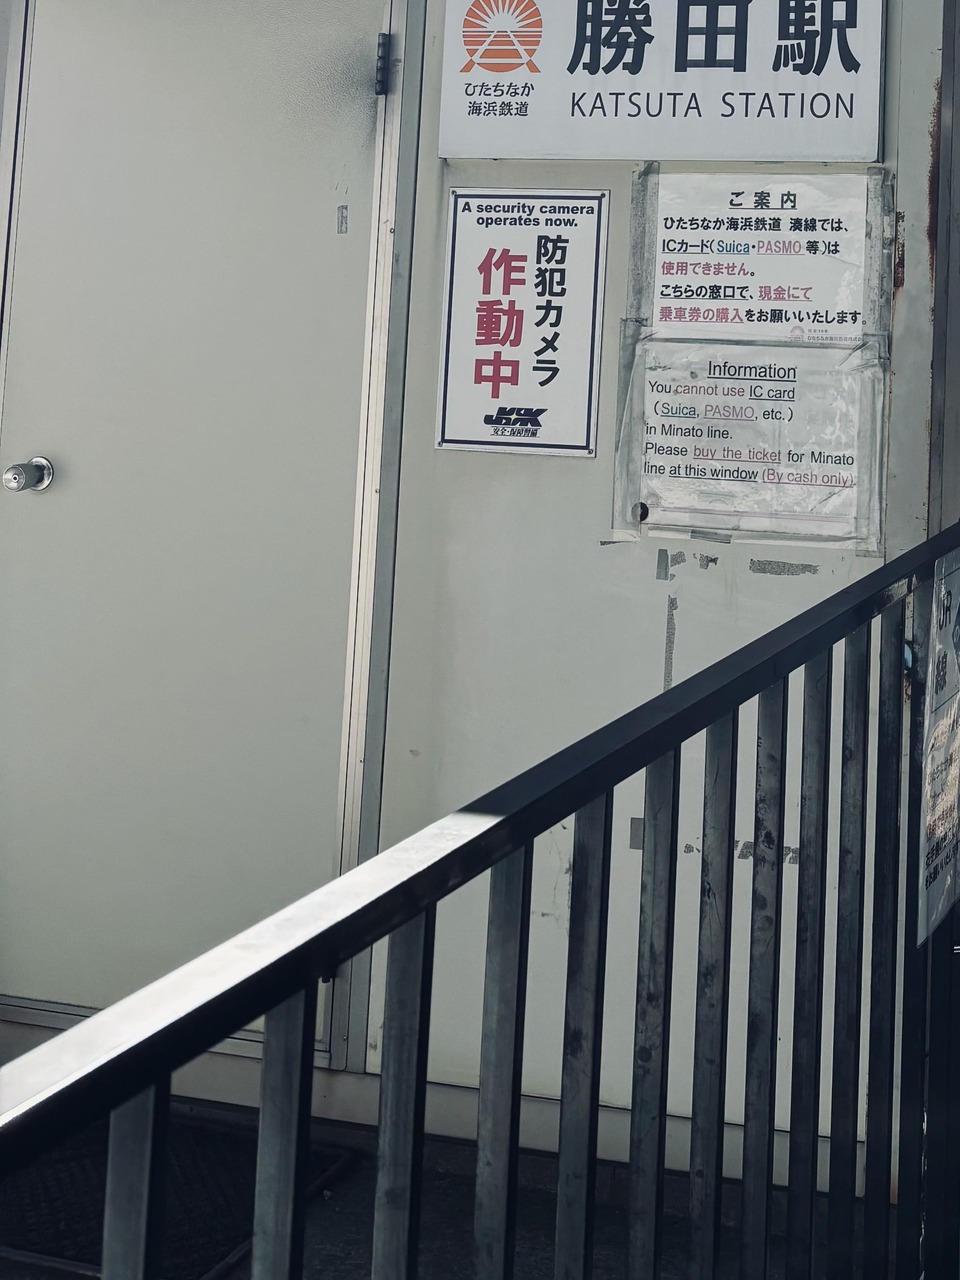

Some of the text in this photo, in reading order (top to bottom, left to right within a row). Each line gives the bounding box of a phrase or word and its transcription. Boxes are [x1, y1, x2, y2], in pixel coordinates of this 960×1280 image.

[464, 82, 534, 98] ひたちなか
[467, 101, 529, 117] 海浜鉄道
[571, 92, 855, 119] KATSUTA STATION
[461, 202, 595, 216] A security camera
[476, 216, 578, 228] operates now.
[664, 217, 782, 231] ひたちなか海浜鉄道
[662, 261, 755, 276] 使用できません。
[532, 234, 569, 387] 防犯カメラ
[474, 247, 528, 399] 作動中
[708, 361, 796, 379] Information
[649, 381, 795, 399] You cannot use IC card
[704, 404, 758, 420] PASMO,
[646, 423, 733, 439] in Minato line.
[645, 442, 855, 466] Please buy the ticket for Minato
[644, 461, 665, 474] line
[669, 465, 683, 477] at
[685, 463, 707, 477] this
[711, 466, 758, 480] window
[762, 468, 783, 484] (By
[787, 470, 817, 484] cash
[938, 589, 952, 632] JR
